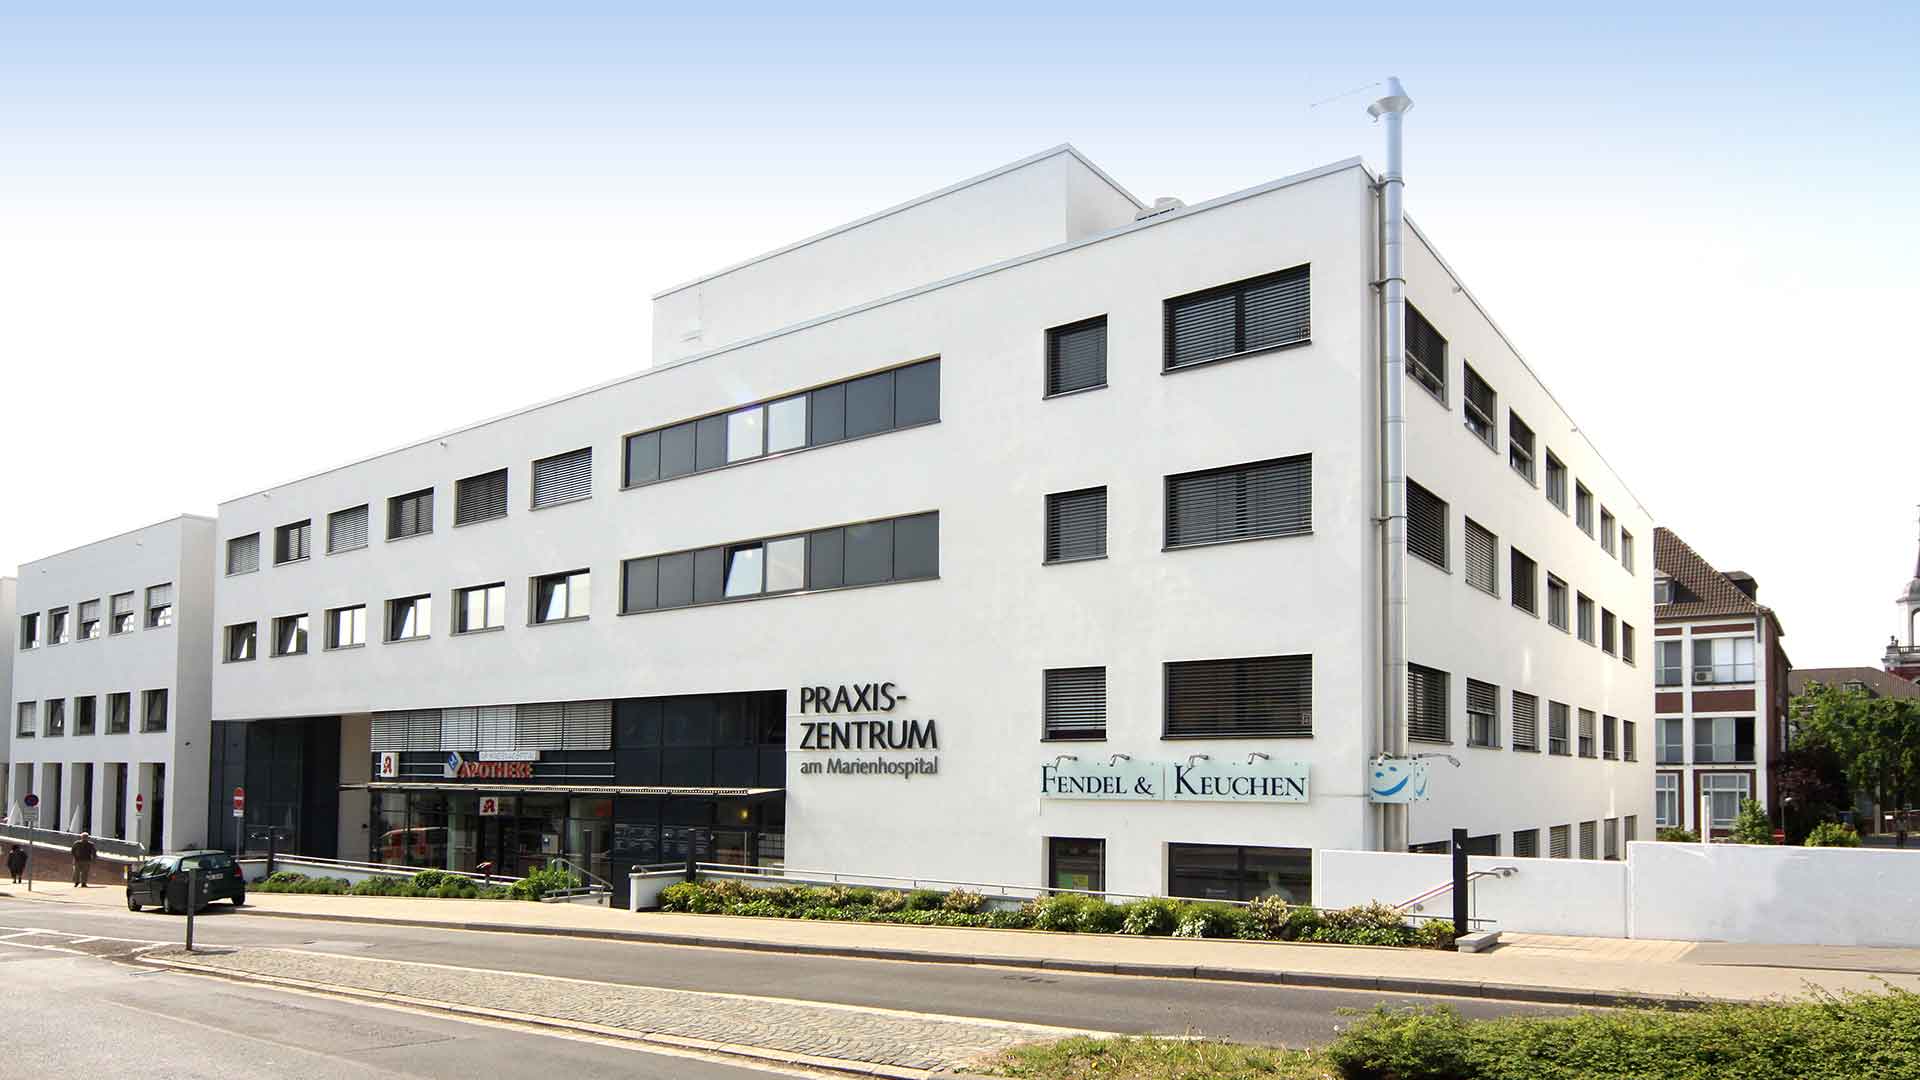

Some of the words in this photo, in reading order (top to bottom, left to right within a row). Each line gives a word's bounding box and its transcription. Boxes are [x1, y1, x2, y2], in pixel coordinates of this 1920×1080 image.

[800, 682, 907, 713] PRAXIS-
[800, 719, 938, 750] ZENTRUM
[459, 761, 533, 779] APOTHEKE
[800, 761, 822, 775] am
[826, 756, 938, 779] Marienhospital
[1134, 776, 1156, 795] &
